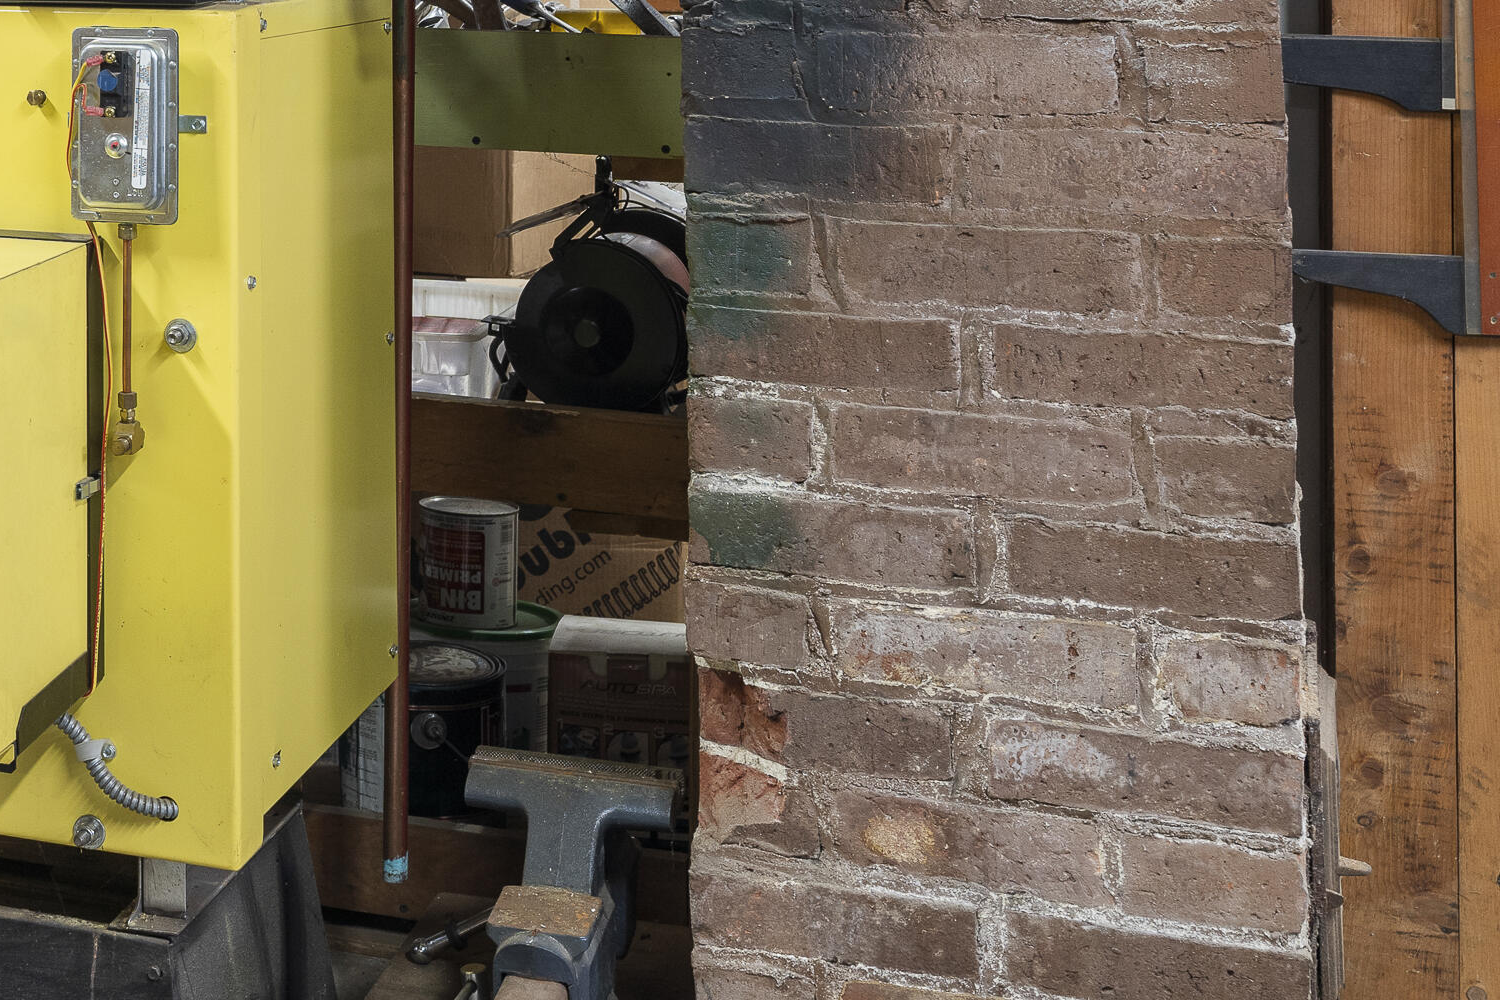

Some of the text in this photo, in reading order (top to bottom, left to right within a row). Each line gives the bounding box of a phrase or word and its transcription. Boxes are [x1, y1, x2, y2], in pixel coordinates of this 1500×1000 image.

[424, 563, 482, 584] PRIMER
[535, 550, 613, 605] ding.com
[440, 588, 481, 610] BIN
